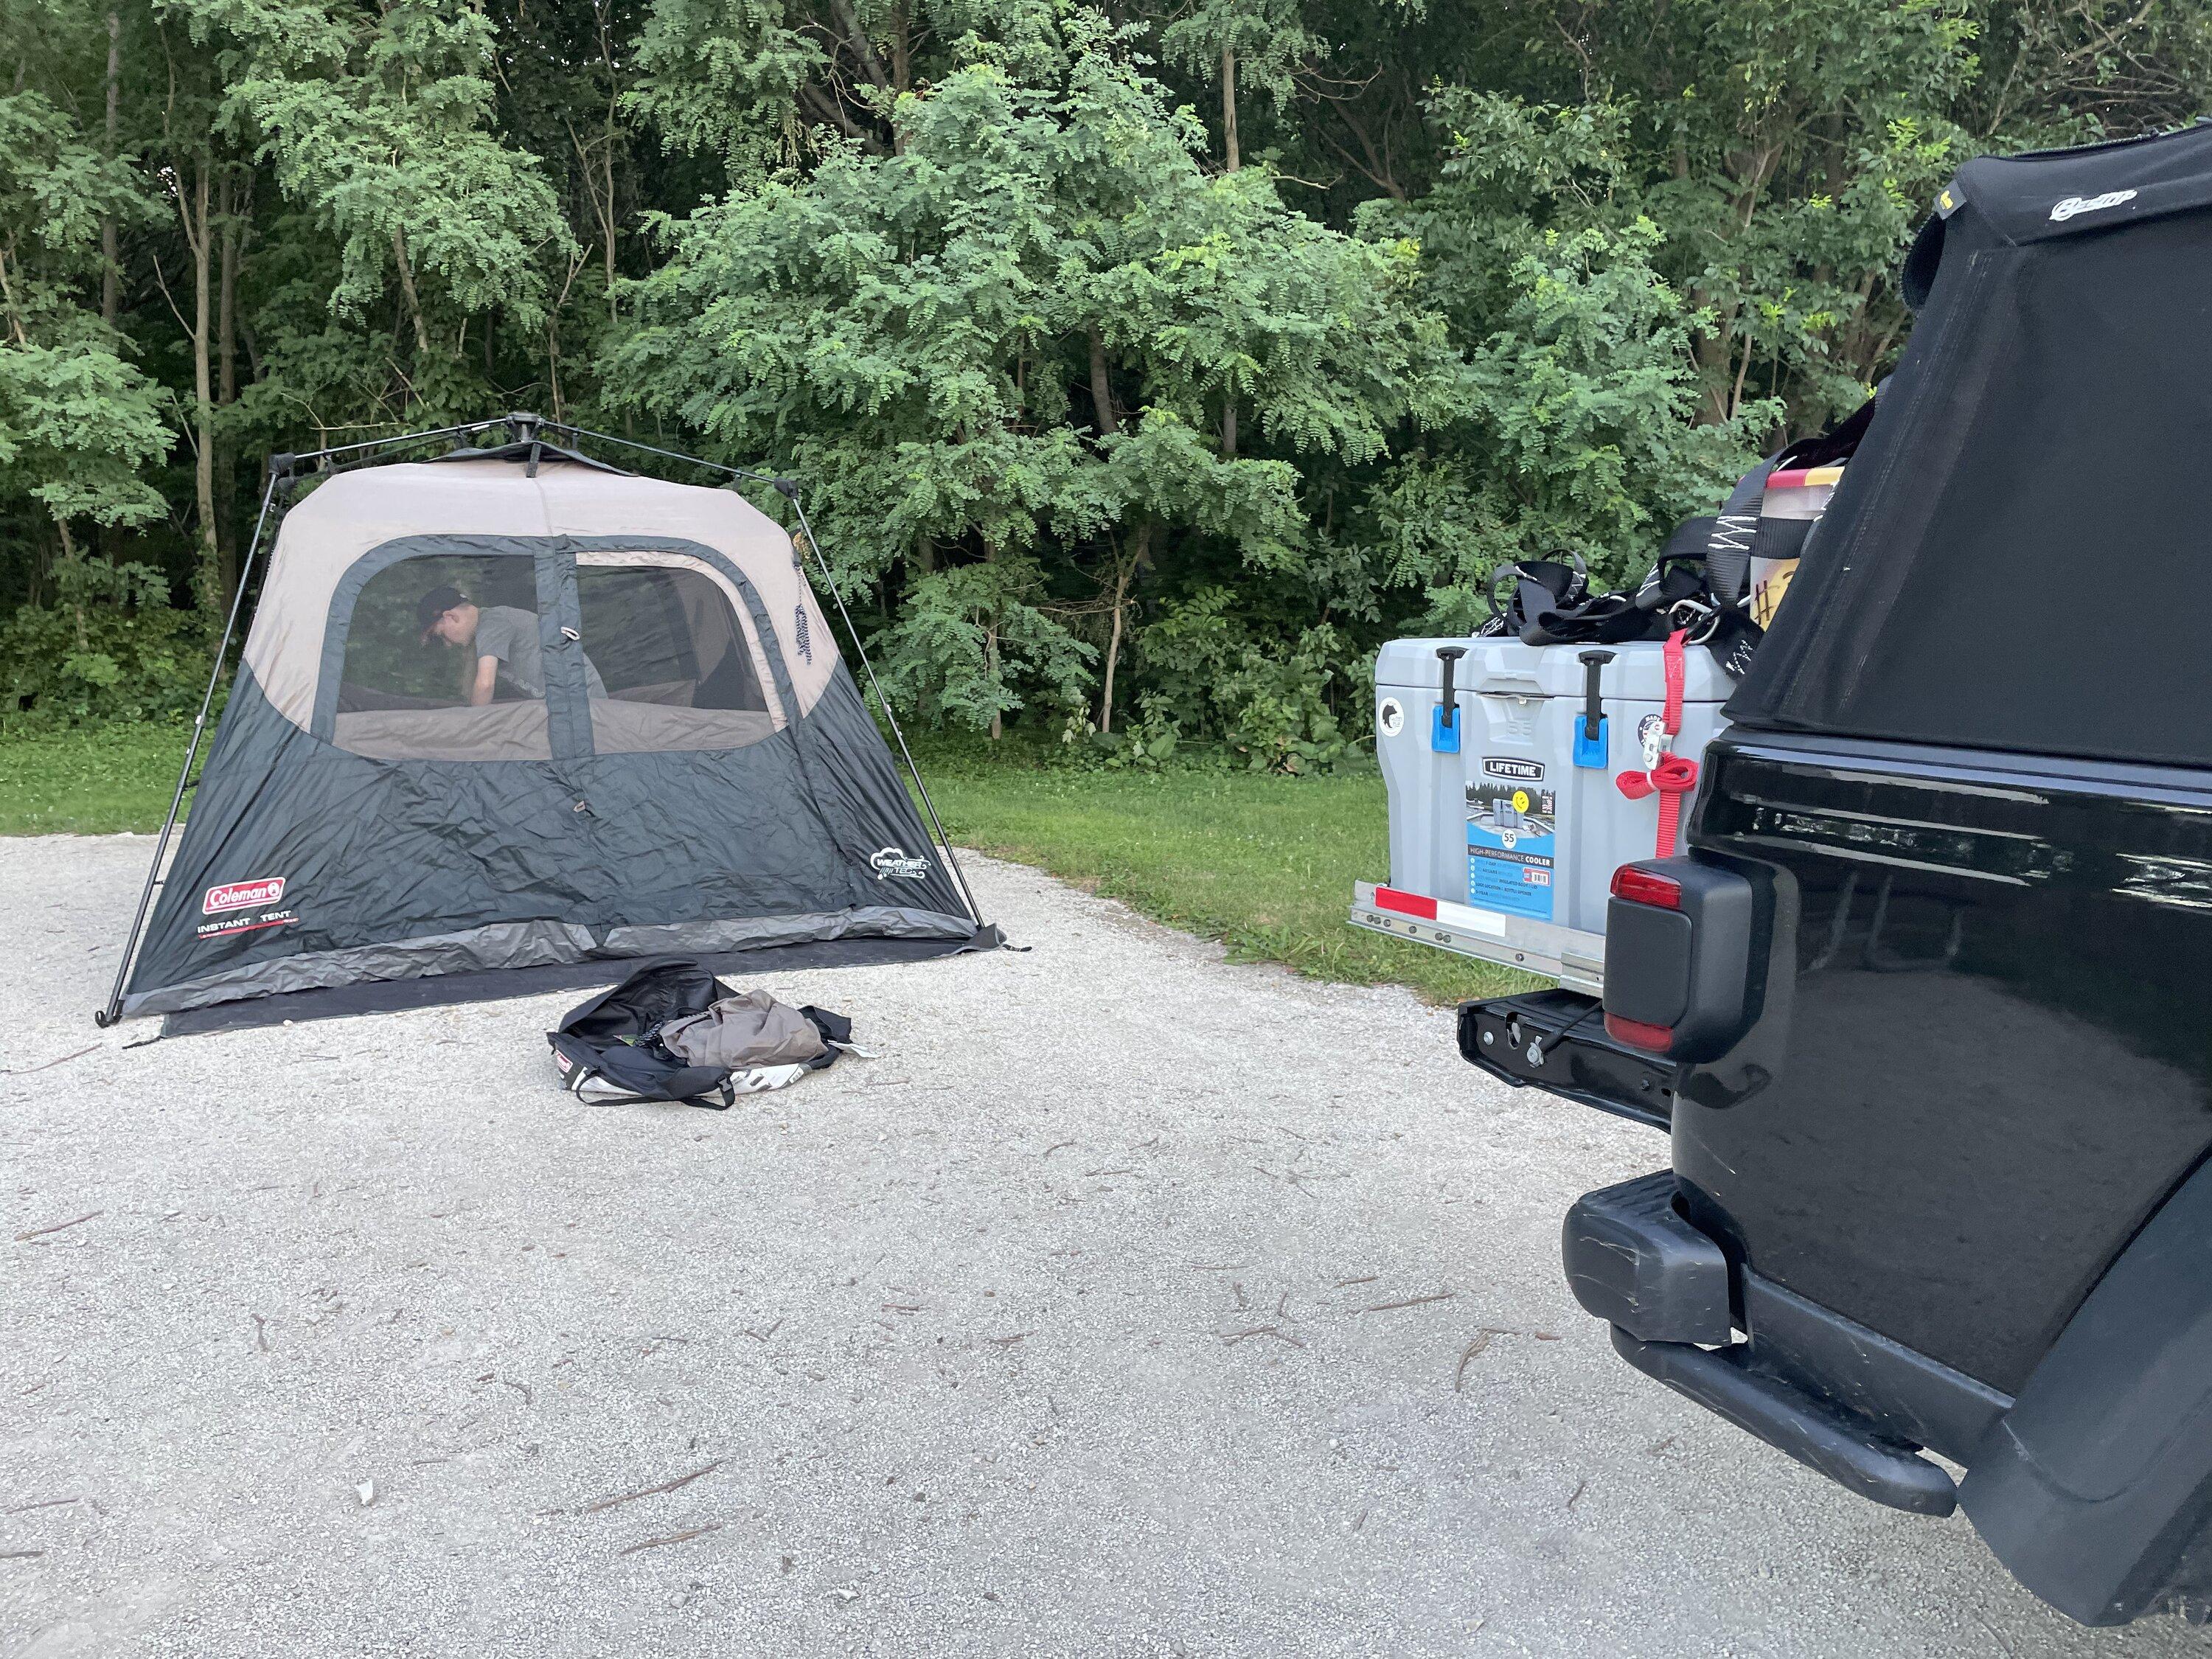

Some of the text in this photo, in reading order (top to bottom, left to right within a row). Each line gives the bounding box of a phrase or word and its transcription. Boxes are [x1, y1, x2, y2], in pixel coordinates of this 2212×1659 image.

[1489, 761, 1537, 777] LIFETIME
[1503, 832, 1514, 843] 55
[876, 858, 922, 868] WEATHER
[1470, 847, 1524, 862] HIGH-PERFORMANCE
[1525, 855, 1551, 866] COOLER
[209, 886, 267, 907] Coleman
[197, 917, 251, 933] INSTANT
[260, 910, 292, 922] TENT
